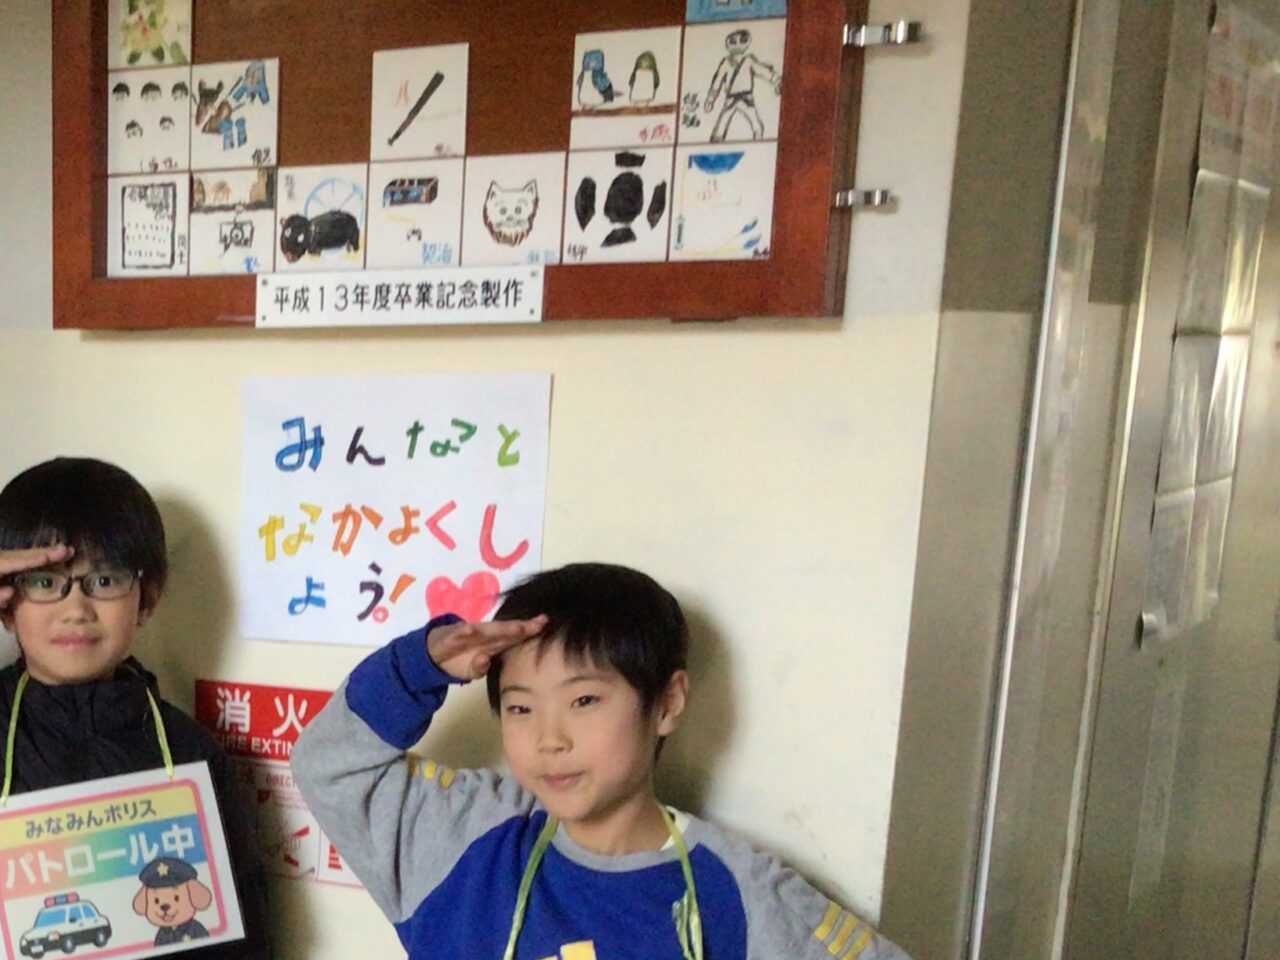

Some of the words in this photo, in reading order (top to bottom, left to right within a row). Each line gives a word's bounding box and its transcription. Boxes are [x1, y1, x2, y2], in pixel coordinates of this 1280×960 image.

[274, 416, 521, 472] みんなと
[257, 500, 530, 571] なかよくし
[6, 824, 194, 889] パトロール中
